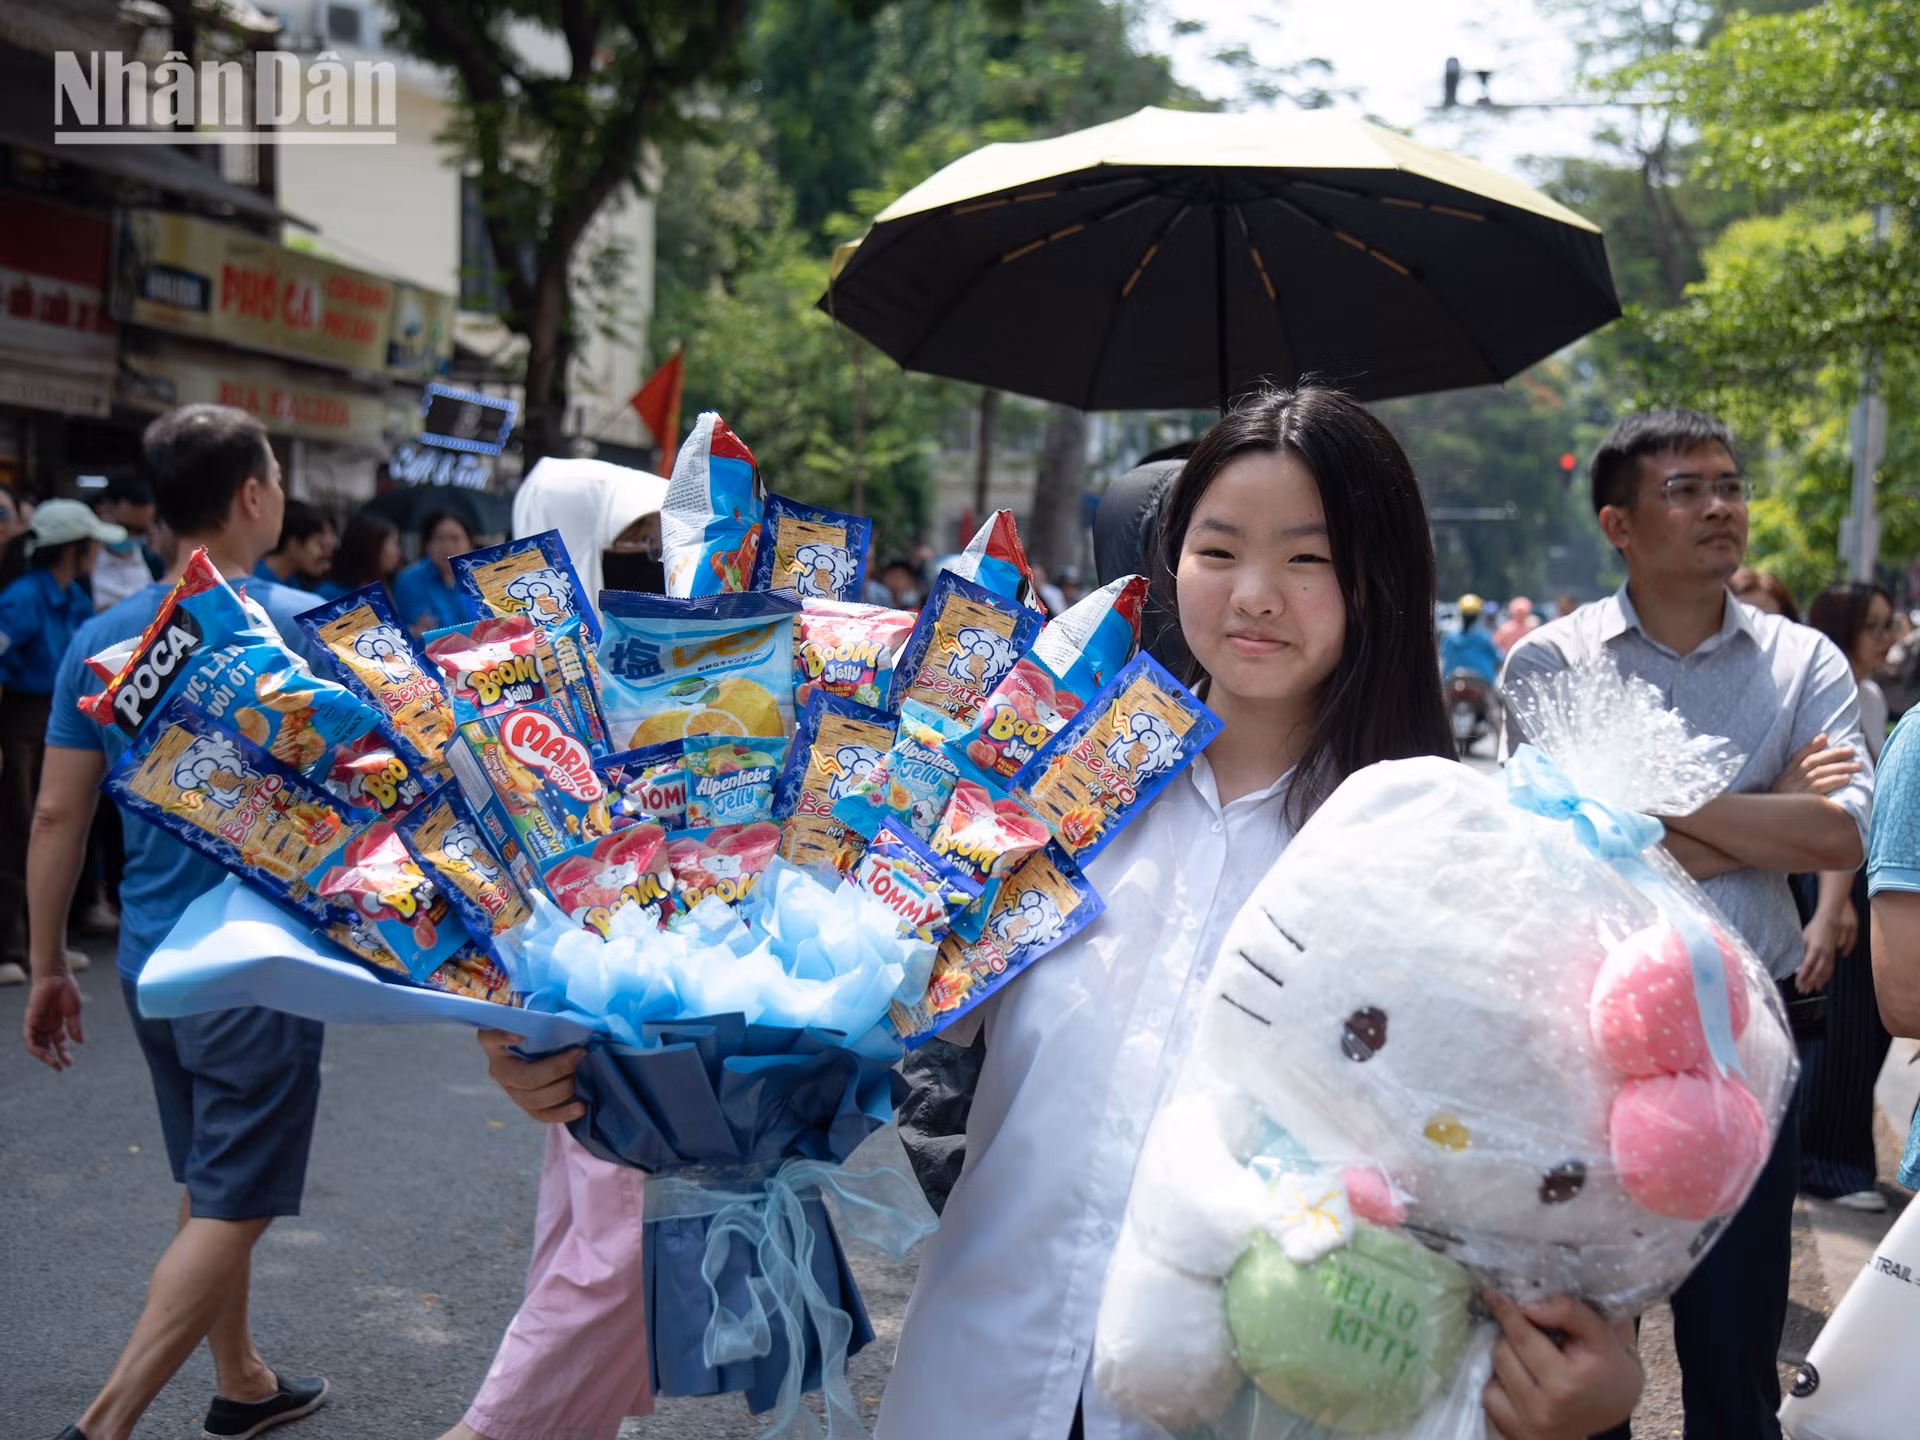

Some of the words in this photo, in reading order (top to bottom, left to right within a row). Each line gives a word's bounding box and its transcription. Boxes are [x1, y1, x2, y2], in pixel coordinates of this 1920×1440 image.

[115, 624, 200, 728] POCA
[375, 678, 441, 714] Bento
[512, 714, 599, 799] MARINE
[550, 766, 576, 792] BOY
[696, 768, 772, 798] Alpenliebe
[898, 759, 944, 785] Jelly
[1068, 737, 1136, 804] Bento
[214, 774, 284, 847] Bento
[713, 784, 756, 817] Jelly
[865, 858, 942, 927] TOMMY
[1322, 1262, 1419, 1332] HELLO
[1874, 1256, 1912, 1283] TRAIL
[1326, 1304, 1420, 1376] KITTY
